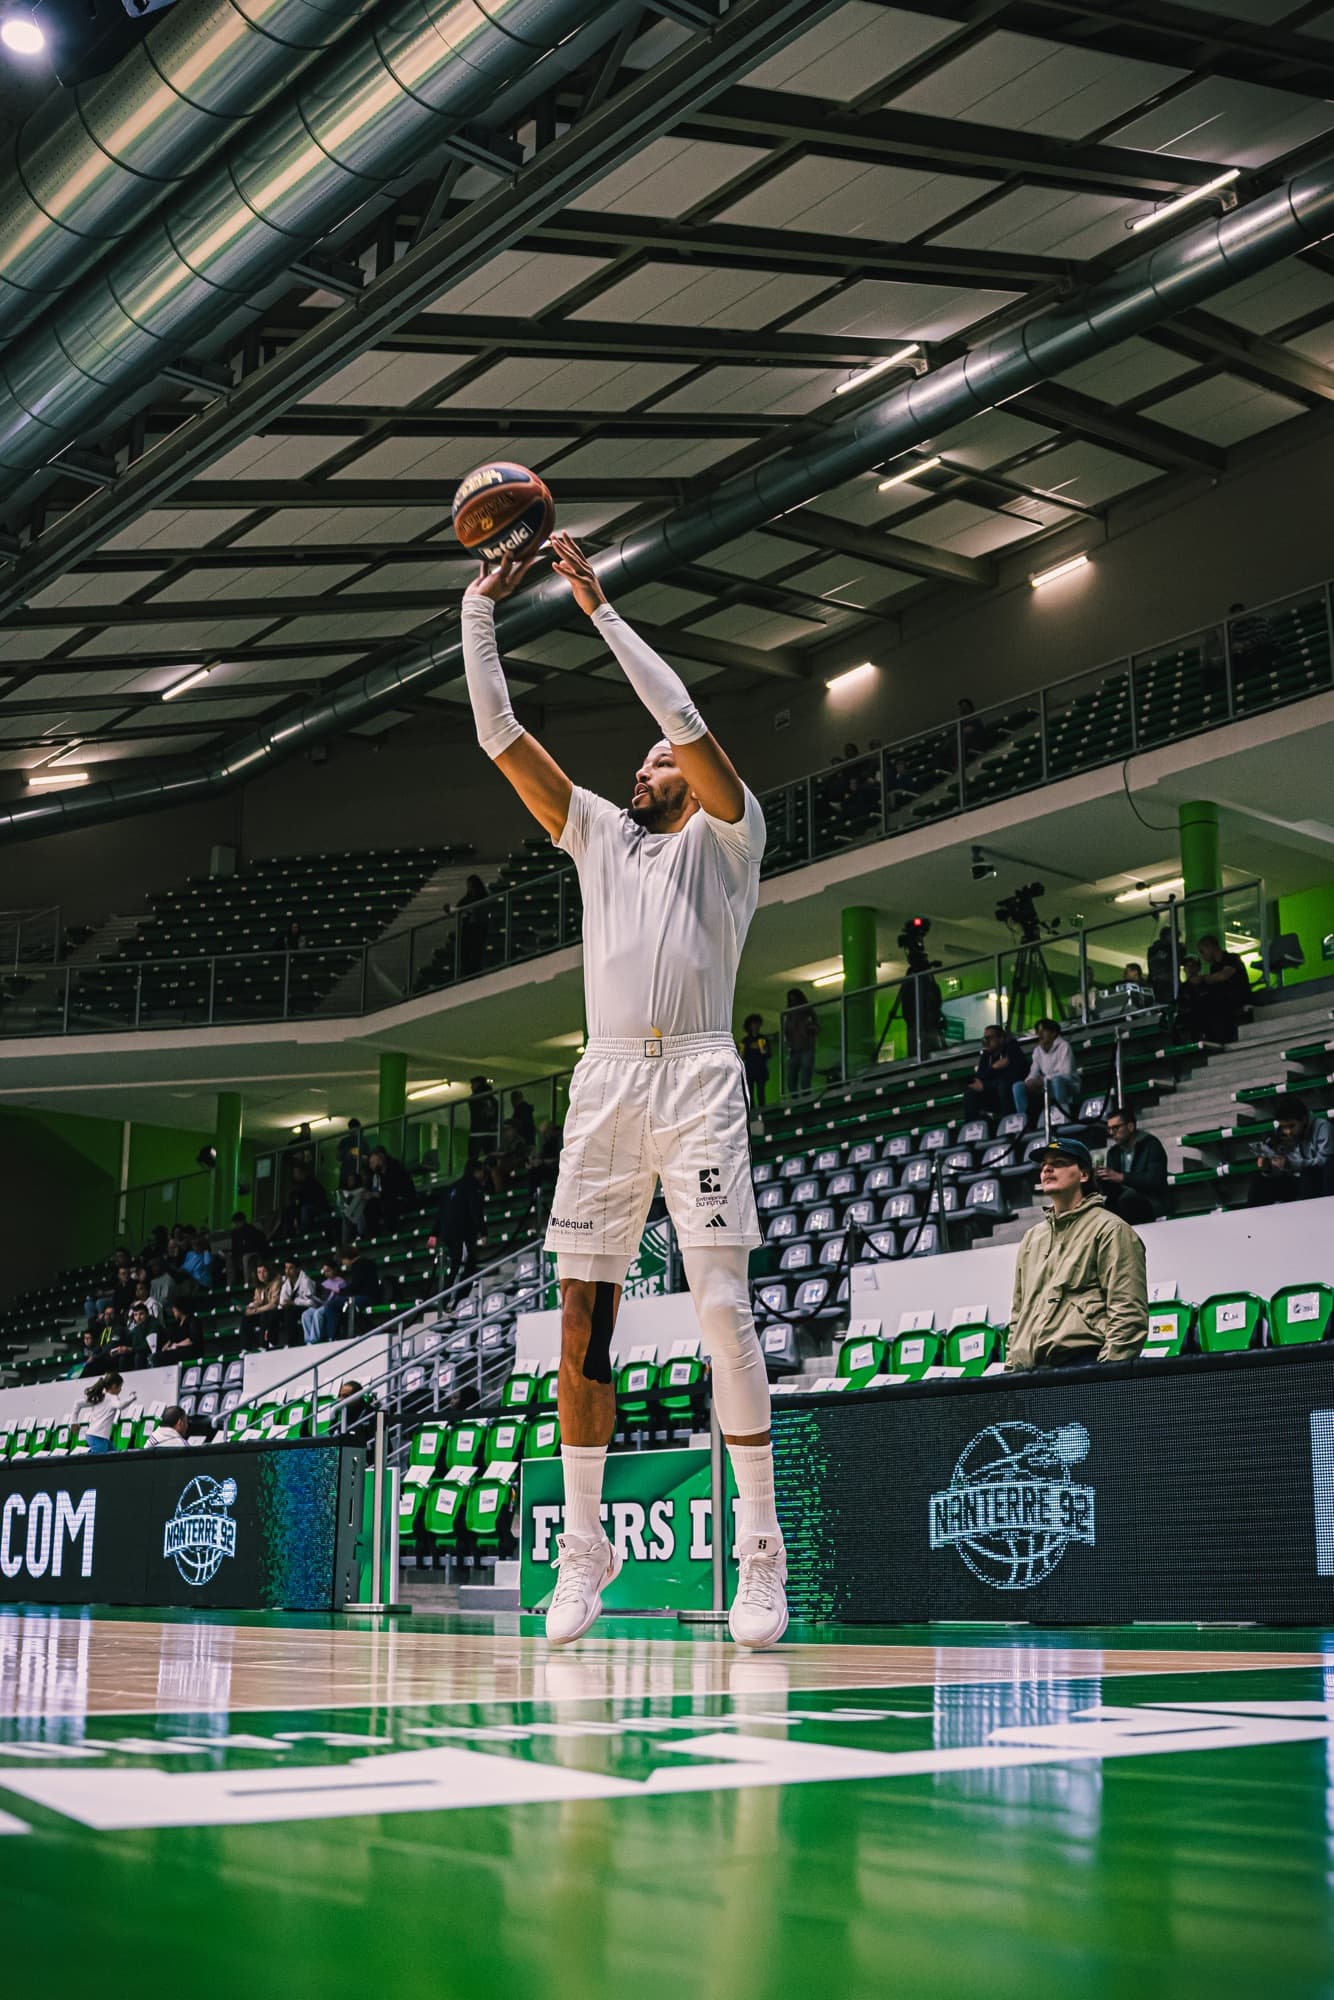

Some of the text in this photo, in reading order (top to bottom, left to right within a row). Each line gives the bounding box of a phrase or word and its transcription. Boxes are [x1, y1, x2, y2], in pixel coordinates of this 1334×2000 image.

[555, 1217, 593, 1230] Adéquat
[1, 1489, 96, 1578] COM
[166, 1518, 234, 1551] NANTERRE 92
[532, 1501, 675, 1560] FRS
[935, 1487, 1089, 1537] NANTERRE 92
